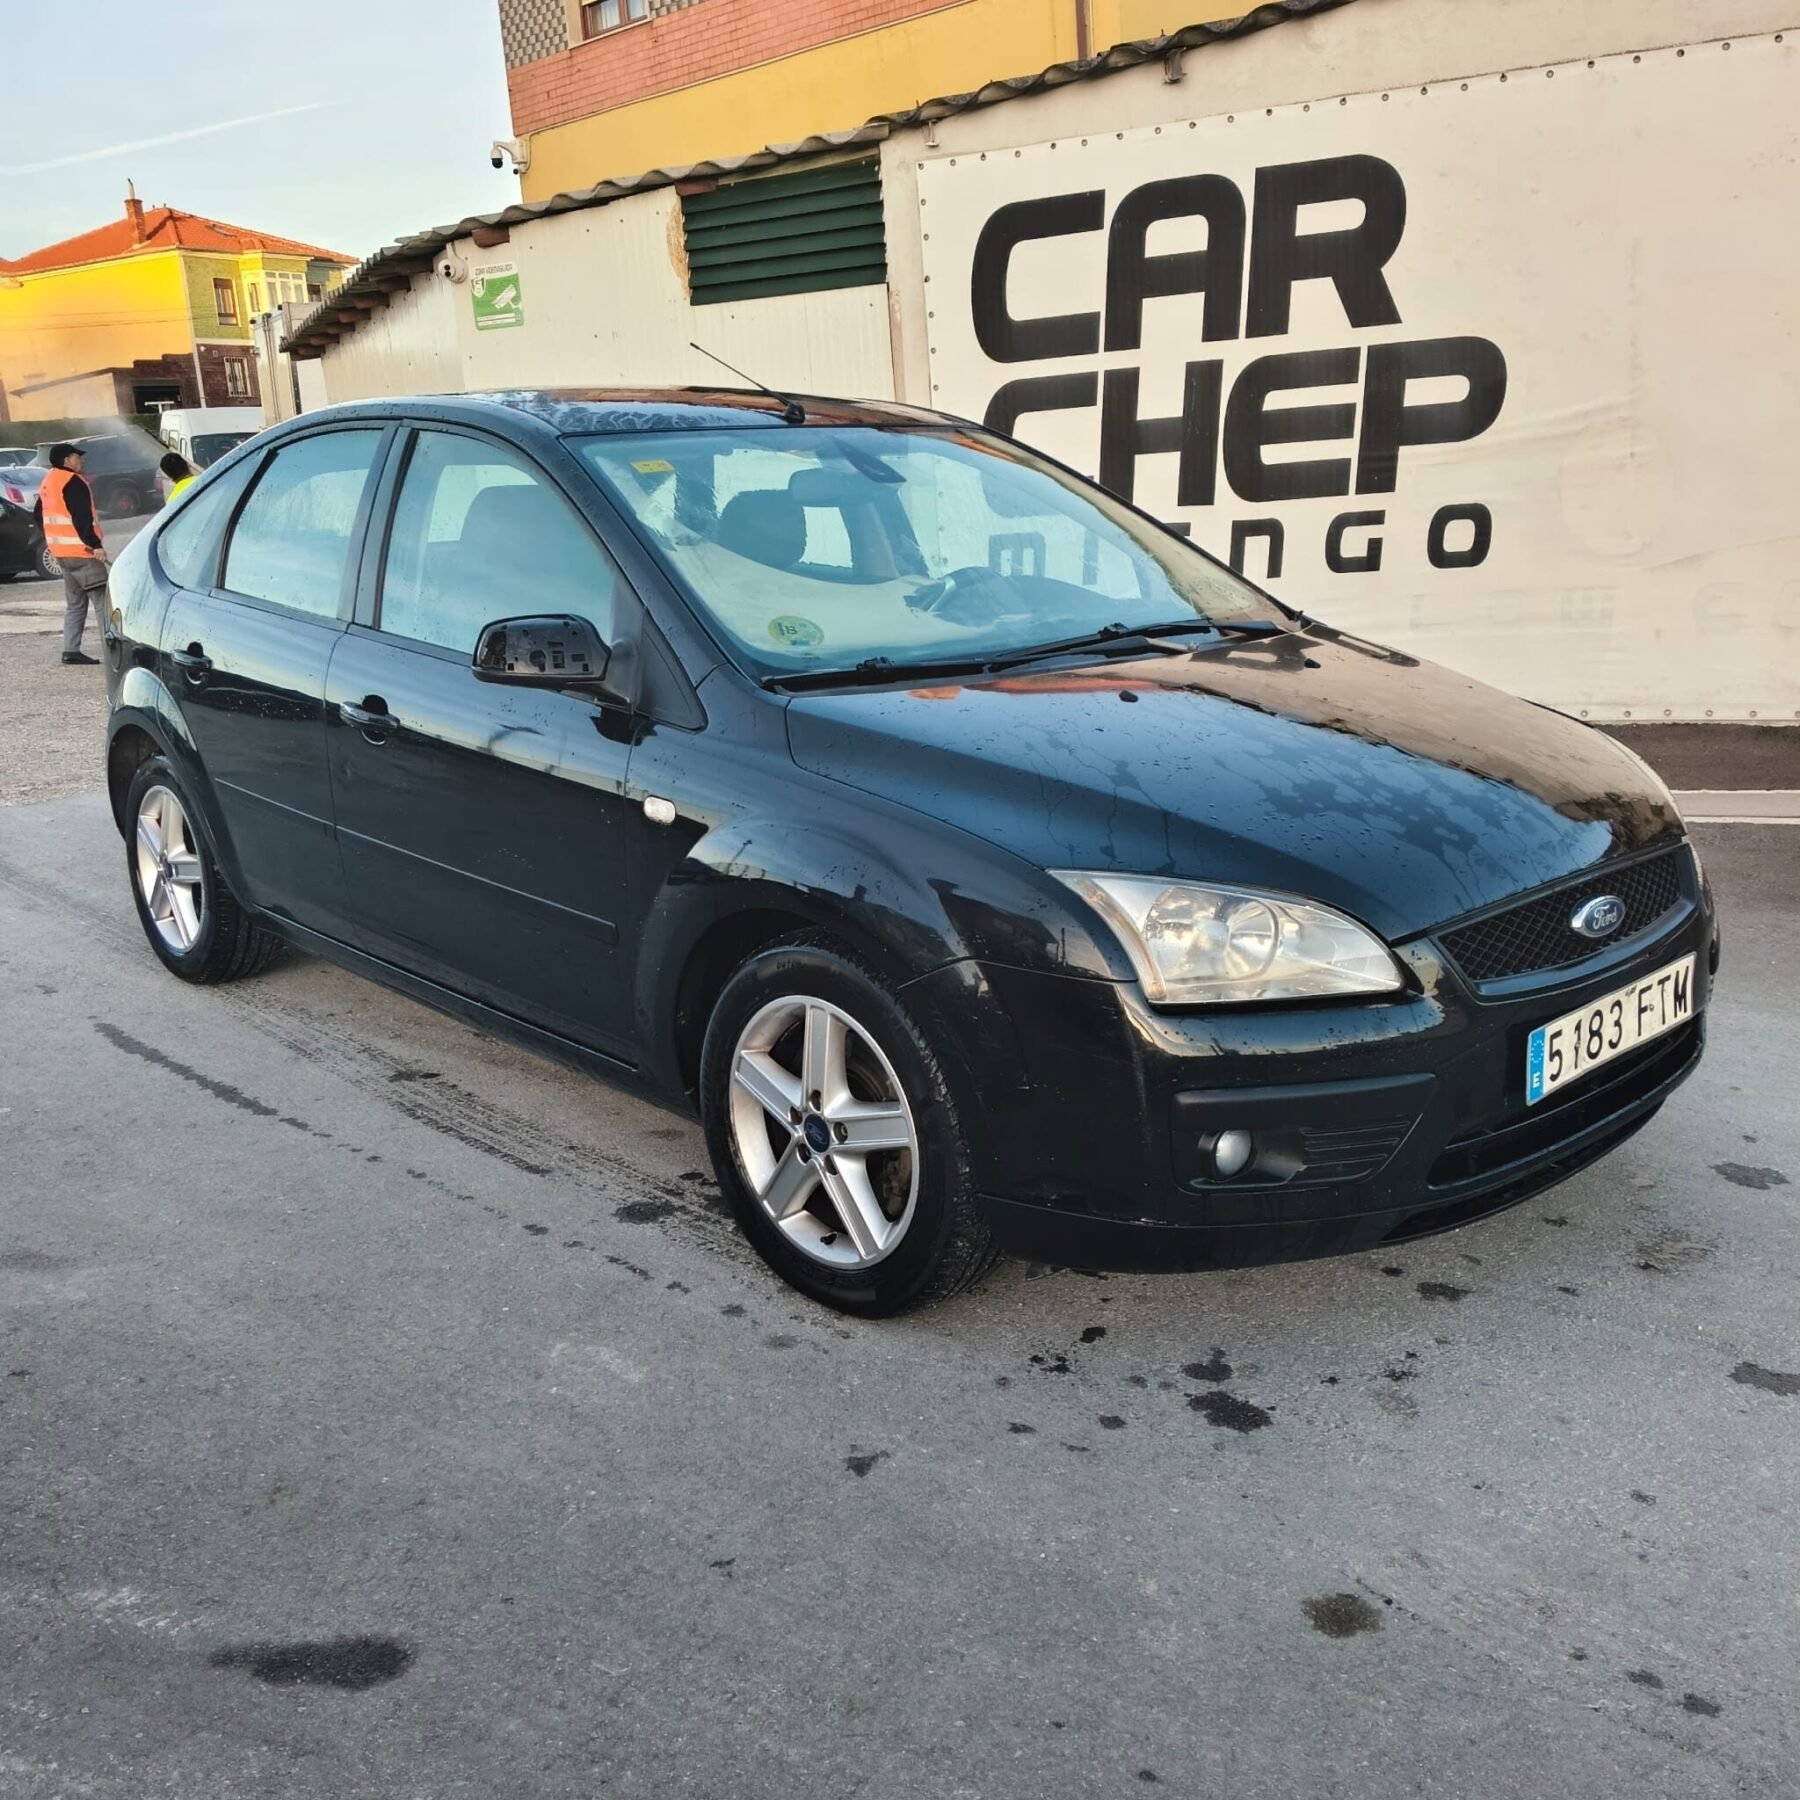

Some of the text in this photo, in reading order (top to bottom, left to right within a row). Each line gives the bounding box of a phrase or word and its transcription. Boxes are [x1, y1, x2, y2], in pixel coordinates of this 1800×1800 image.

[971, 154, 1407, 363] CAR
[982, 335, 1508, 508] CHEP
[1592, 903, 1618, 930] Ford
[1549, 965, 1691, 1082] 5183 FTM
